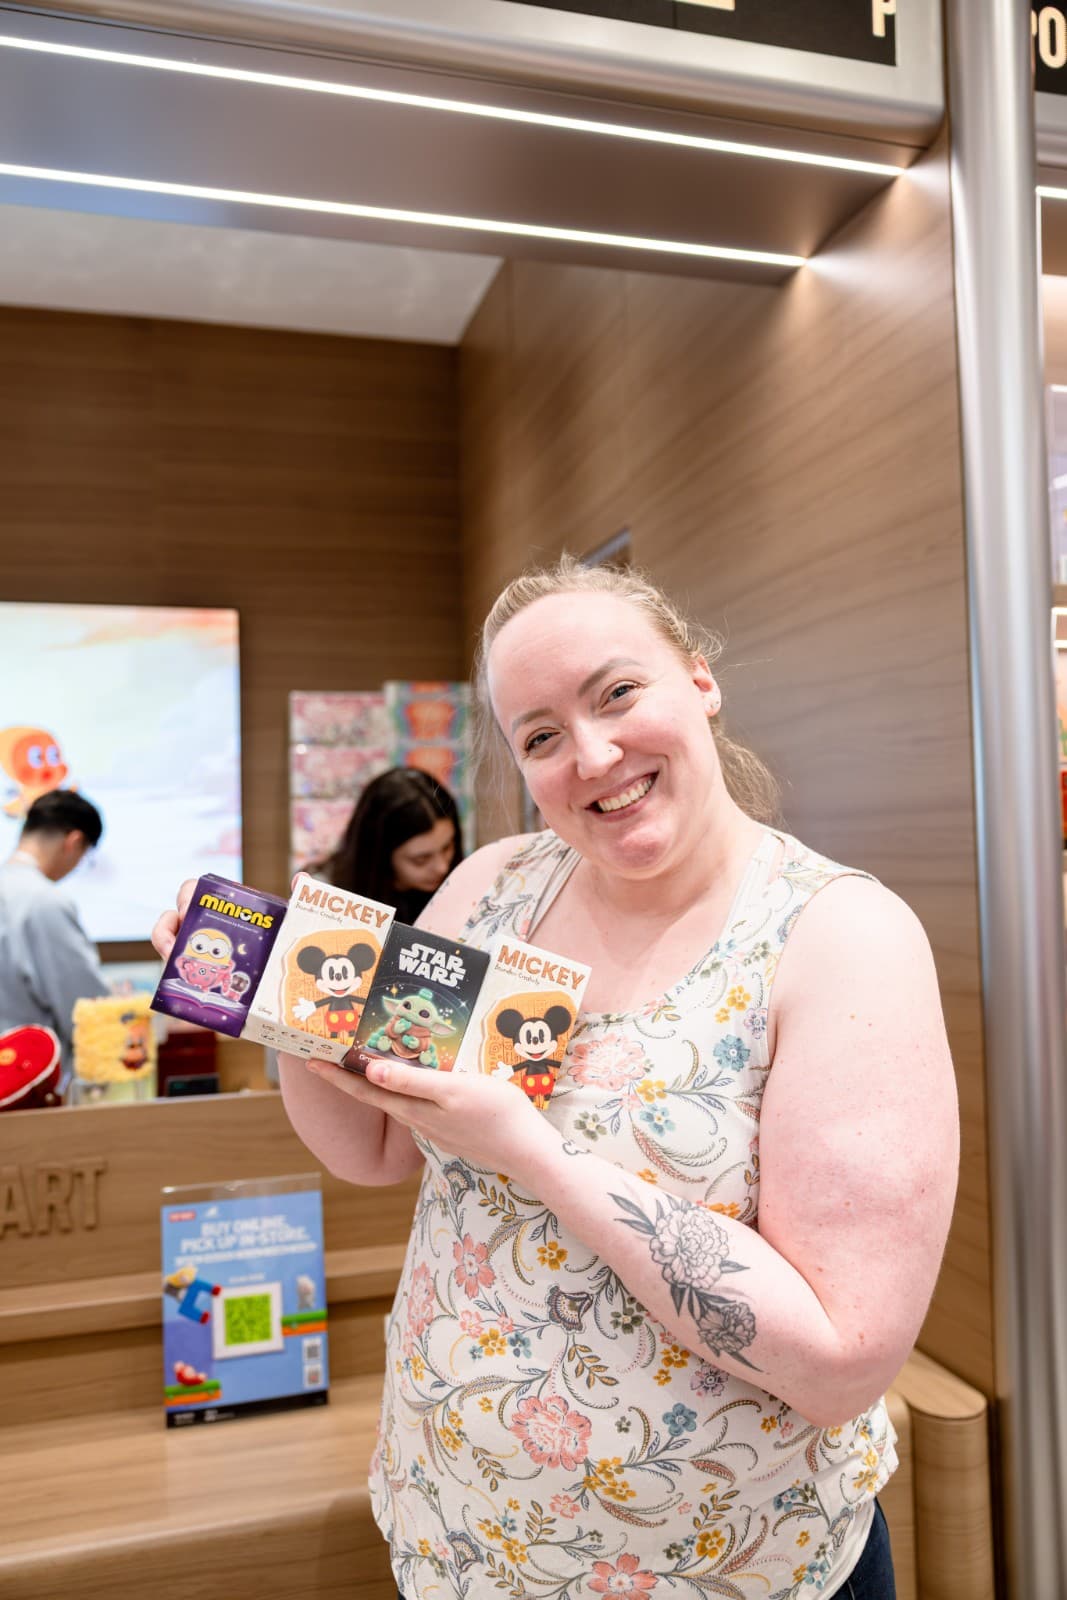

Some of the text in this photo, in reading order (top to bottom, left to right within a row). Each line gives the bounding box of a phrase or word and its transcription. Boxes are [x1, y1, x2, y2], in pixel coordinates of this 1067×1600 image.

[298, 885, 390, 928] MICKEY
[398, 953, 465, 987] WARS
[400, 943, 467, 975] STAR
[497, 945, 586, 990] MICKEY
